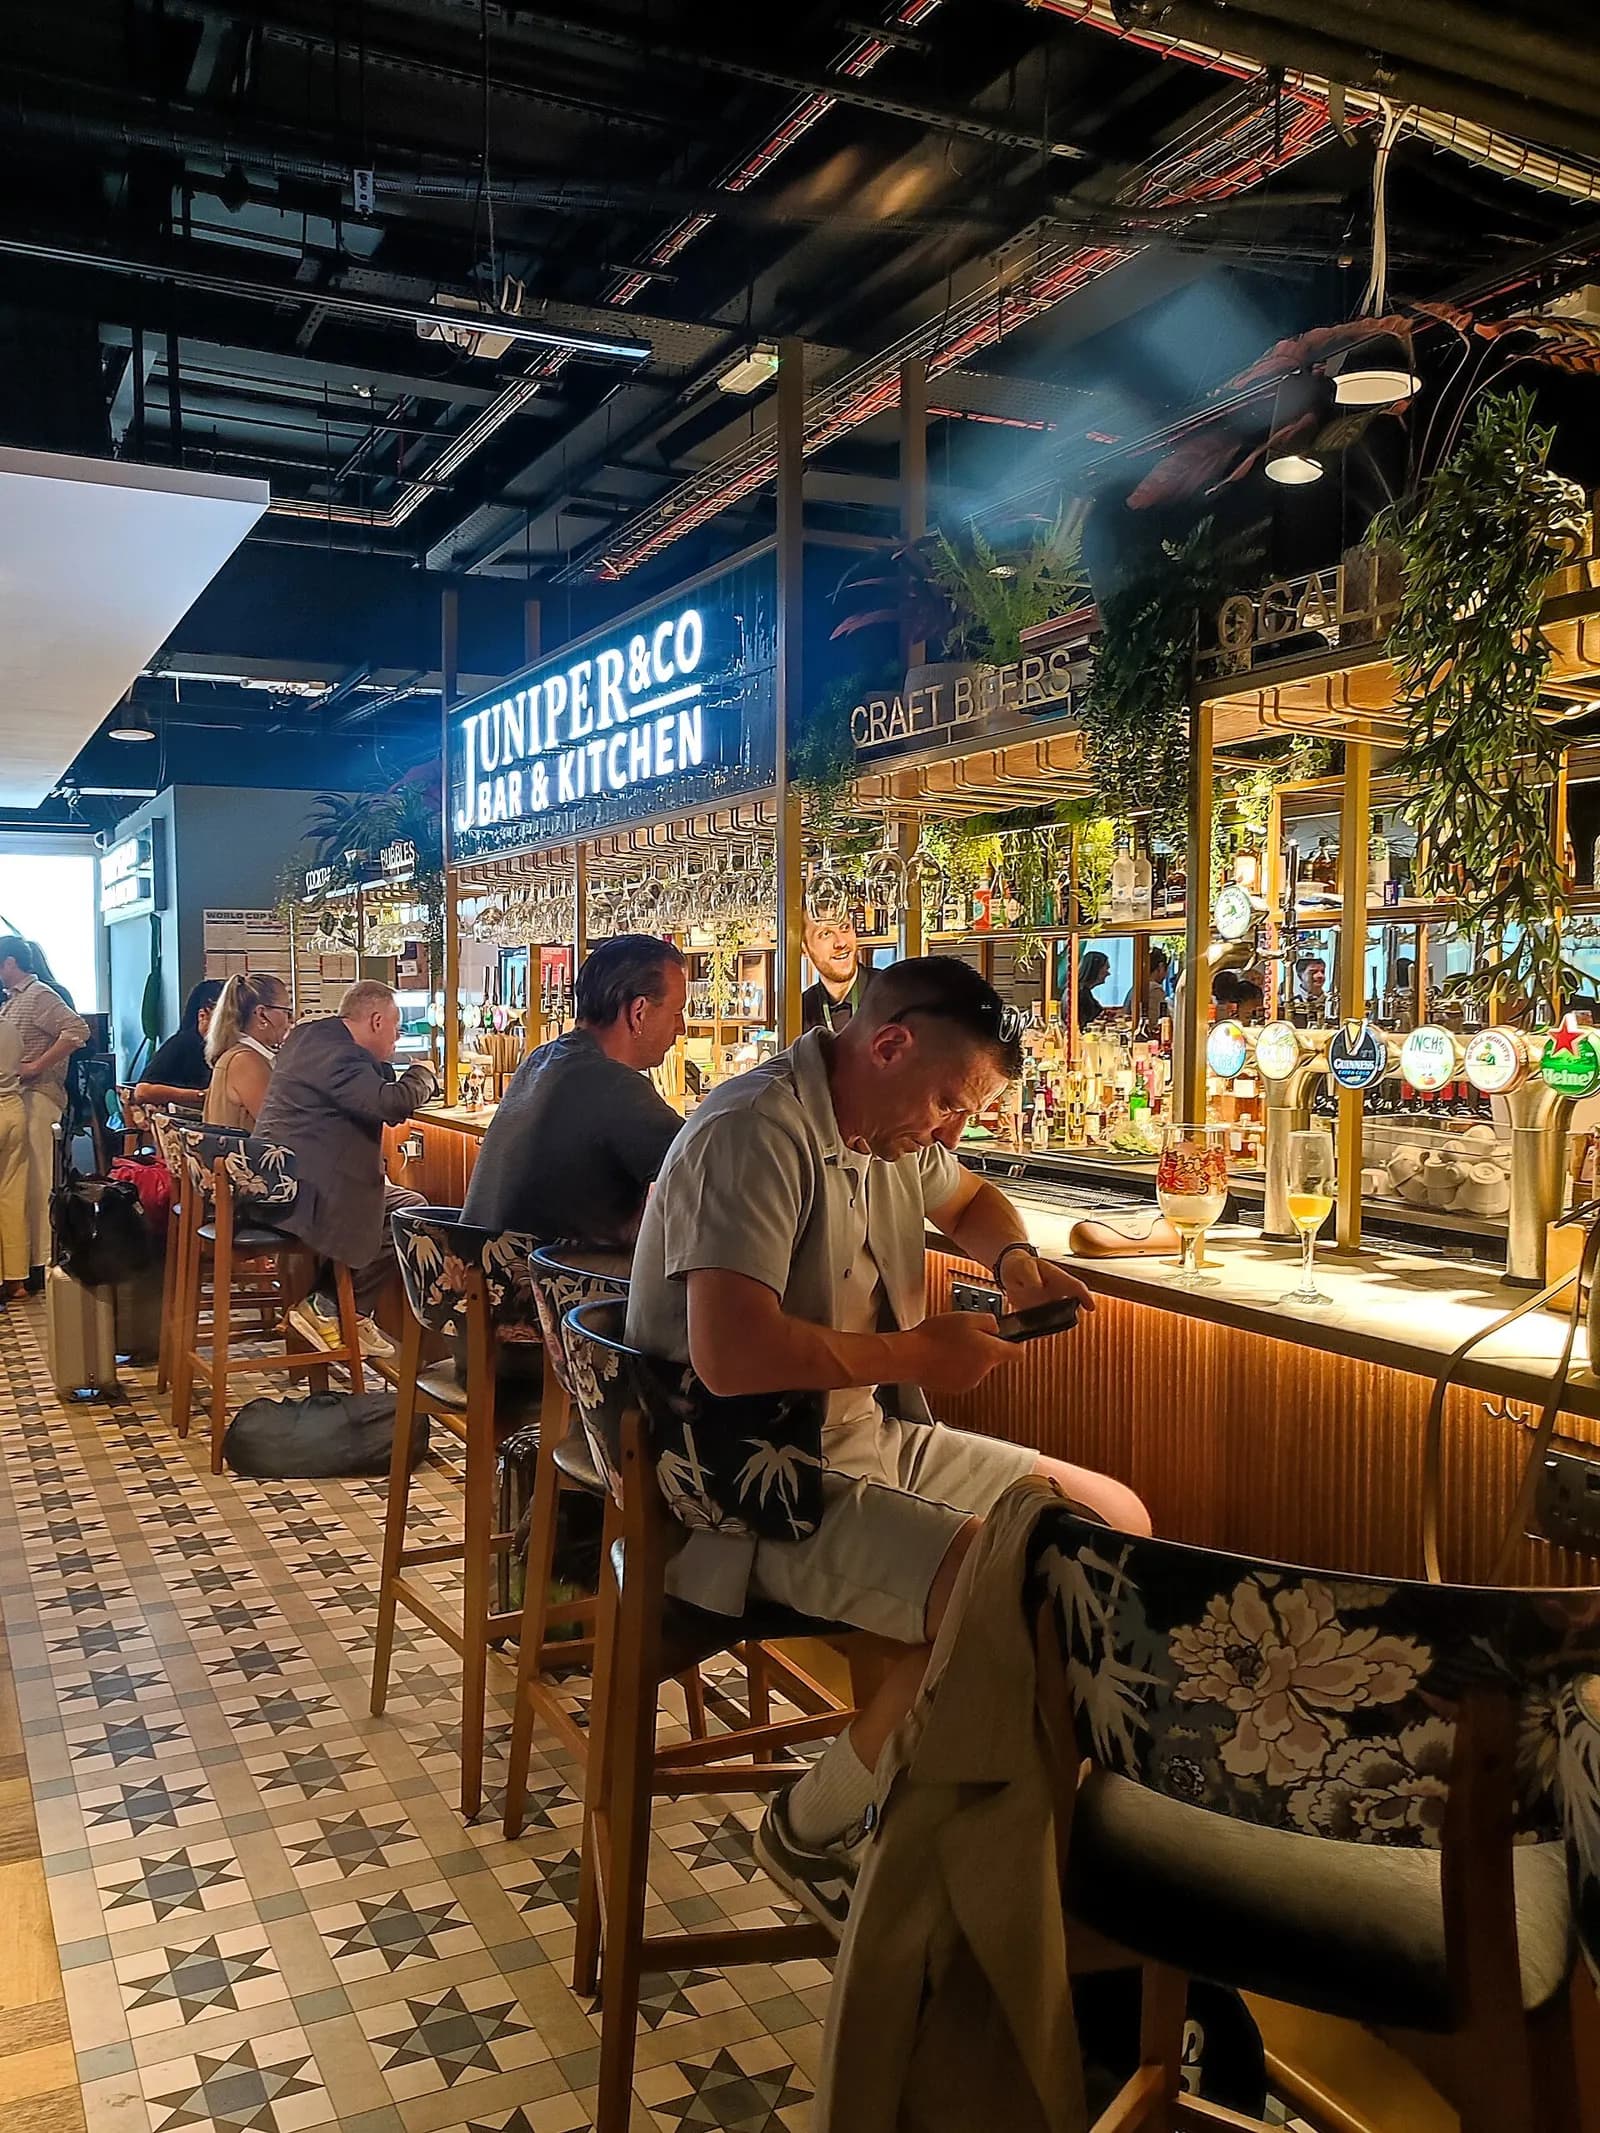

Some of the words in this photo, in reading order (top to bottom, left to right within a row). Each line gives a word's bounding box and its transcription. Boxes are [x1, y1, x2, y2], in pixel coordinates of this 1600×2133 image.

[850, 684, 944, 746] CRAFT
[477, 769, 523, 828] BAR
[530, 761, 550, 813] &
[558, 705, 705, 805] KITCHEN
[380, 840, 416, 870] BUBBLES
[206, 911, 244, 919] WORLD
[245, 911, 267, 919] CUP
[1333, 1058, 1375, 1070] GUINNESS
